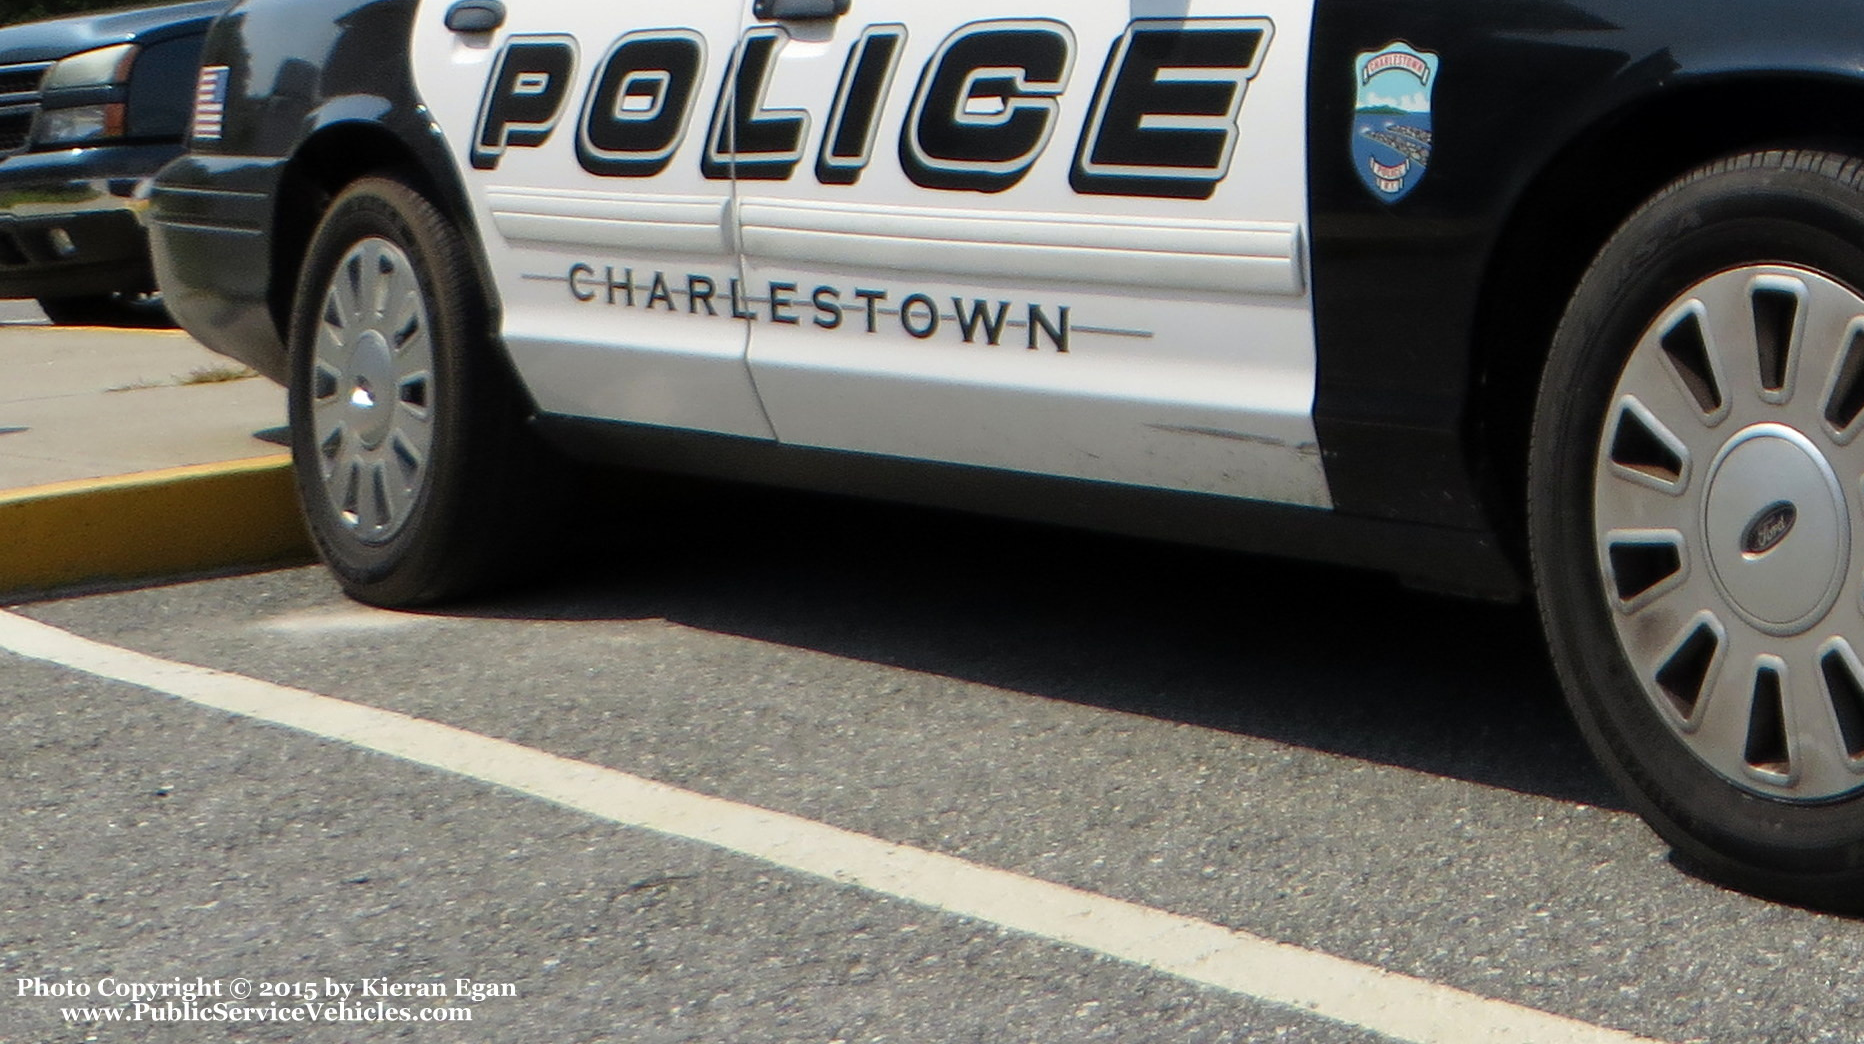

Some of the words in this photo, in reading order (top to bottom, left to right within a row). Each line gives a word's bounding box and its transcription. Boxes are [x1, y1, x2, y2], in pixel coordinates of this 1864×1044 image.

[470, 16, 1275, 201] POLICE
[567, 262, 1072, 353] CHARLESTOWN
[1757, 515, 1785, 546] Ford
